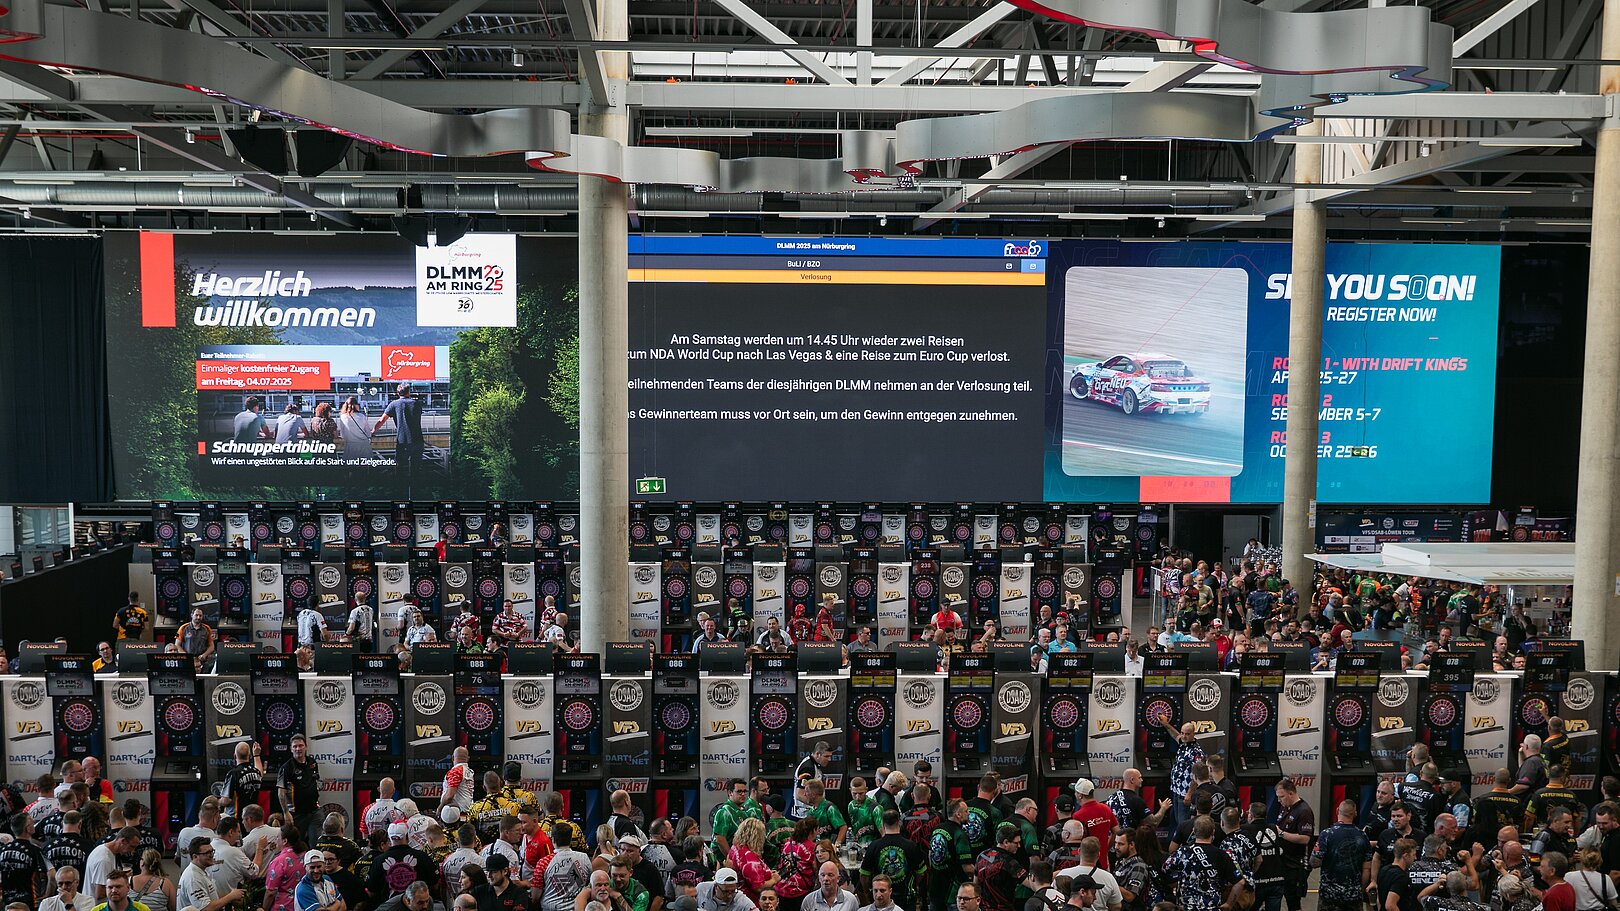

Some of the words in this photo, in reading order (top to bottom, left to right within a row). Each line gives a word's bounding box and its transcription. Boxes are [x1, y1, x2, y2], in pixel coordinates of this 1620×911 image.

[822, 243, 855, 251] Nürburgring
[426, 266, 483, 279] DLMM
[800, 273, 832, 281] Verlosung
[191, 271, 312, 297] Herzlich
[426, 281, 446, 290] AM
[451, 281, 483, 290] RING
[484, 277, 503, 291] 25
[1327, 275, 1385, 300] YOU
[1387, 275, 1476, 301] SOON!
[194, 300, 376, 327] willkommen
[1326, 307, 1397, 322] REGISTER
[1398, 307, 1438, 322] NOW!
[671, 334, 689, 345] Am
[692, 334, 741, 347] Samstag
[744, 334, 783, 345] werden
[787, 337, 803, 345] um
[807, 335, 837, 346] 14.45
[841, 335, 859, 346] Uhr
[862, 335, 898, 346] wieder
[901, 336, 924, 346] zwei
[928, 336, 964, 347] Reisen
[650, 349, 675, 360] NDA
[678, 349, 709, 360] World
[712, 349, 733, 362] Cup
[737, 349, 763, 360] nach
[767, 350, 785, 360] Las
[788, 350, 822, 362] Vegas
[825, 350, 834, 361] &
[836, 350, 858, 361] eine
[862, 350, 890, 361] Reise
[893, 353, 916, 361] zum
[920, 351, 944, 361] Euro
[947, 351, 968, 363] Cup
[971, 351, 1011, 362] verlost.
[201, 364, 239, 374] Einmaliger
[240, 364, 289, 373] kostenfreier
[290, 364, 320, 374] Zugang
[396, 360, 431, 368] nürburgring
[1324, 357, 1331, 370] 1
[1342, 357, 1380, 370] WITH
[1381, 357, 1423, 370] DRIFT
[1424, 357, 1468, 371] KINGS
[215, 378, 245, 387] Freitag,
[246, 378, 292, 386] 04.07.2025
[707, 379, 743, 390] Teams
[747, 379, 764, 390] der
[767, 379, 832, 392] diesjährigen
[836, 380, 870, 391] DLMM
[874, 380, 917, 391] nehmen
[920, 382, 933, 391] an
[936, 380, 954, 391] der
[956, 380, 1010, 393] Verlosung
[1013, 381, 1033, 392] teil.
[1322, 394, 1333, 406] 2
[639, 409, 717, 420] Gewinnerteam
[721, 411, 750, 420] muss
[753, 411, 771, 420] vor
[774, 409, 790, 420] Ort
[793, 410, 818, 422] sein,
[821, 412, 838, 420] um
[841, 409, 860, 420] den
[864, 410, 903, 421] Gewinn
[907, 411, 956, 423] entgegen
[959, 410, 1018, 421] zunehmen.
[1355, 407, 1381, 421] 5-7
[1321, 431, 1331, 444] 3
[211, 440, 336, 456] Schnuppertribüne
[211, 457, 226, 465] Wirf
[246, 457, 287, 467] ungestörten
[287, 457, 303, 465] Blick
[304, 457, 315, 465] auf
[327, 458, 346, 466] Start-
[346, 458, 359, 466] und
[360, 458, 397, 468] Zielgerade.
[62, 661, 78, 669] 092
[165, 660, 179, 668] 091
[267, 660, 282, 668] 090
[469, 660, 484, 668] 088
[571, 660, 587, 668] 087
[768, 659, 782, 667] 085
[1063, 659, 1078, 667] 082
[1352, 658, 1365, 666] 079
[1446, 658, 1459, 666] 078
[471, 676, 483, 684] 76
[1444, 673, 1459, 681] 395
[1538, 673, 1553, 681] 344
[617, 688, 637, 702] DSAB
[1197, 689, 1215, 703] DSAB
[1383, 685, 1402, 699] DSAB
[220, 691, 239, 706] DSAB
[322, 782, 351, 791] DART
[621, 782, 648, 792] DART
[1567, 778, 1593, 788] DART
